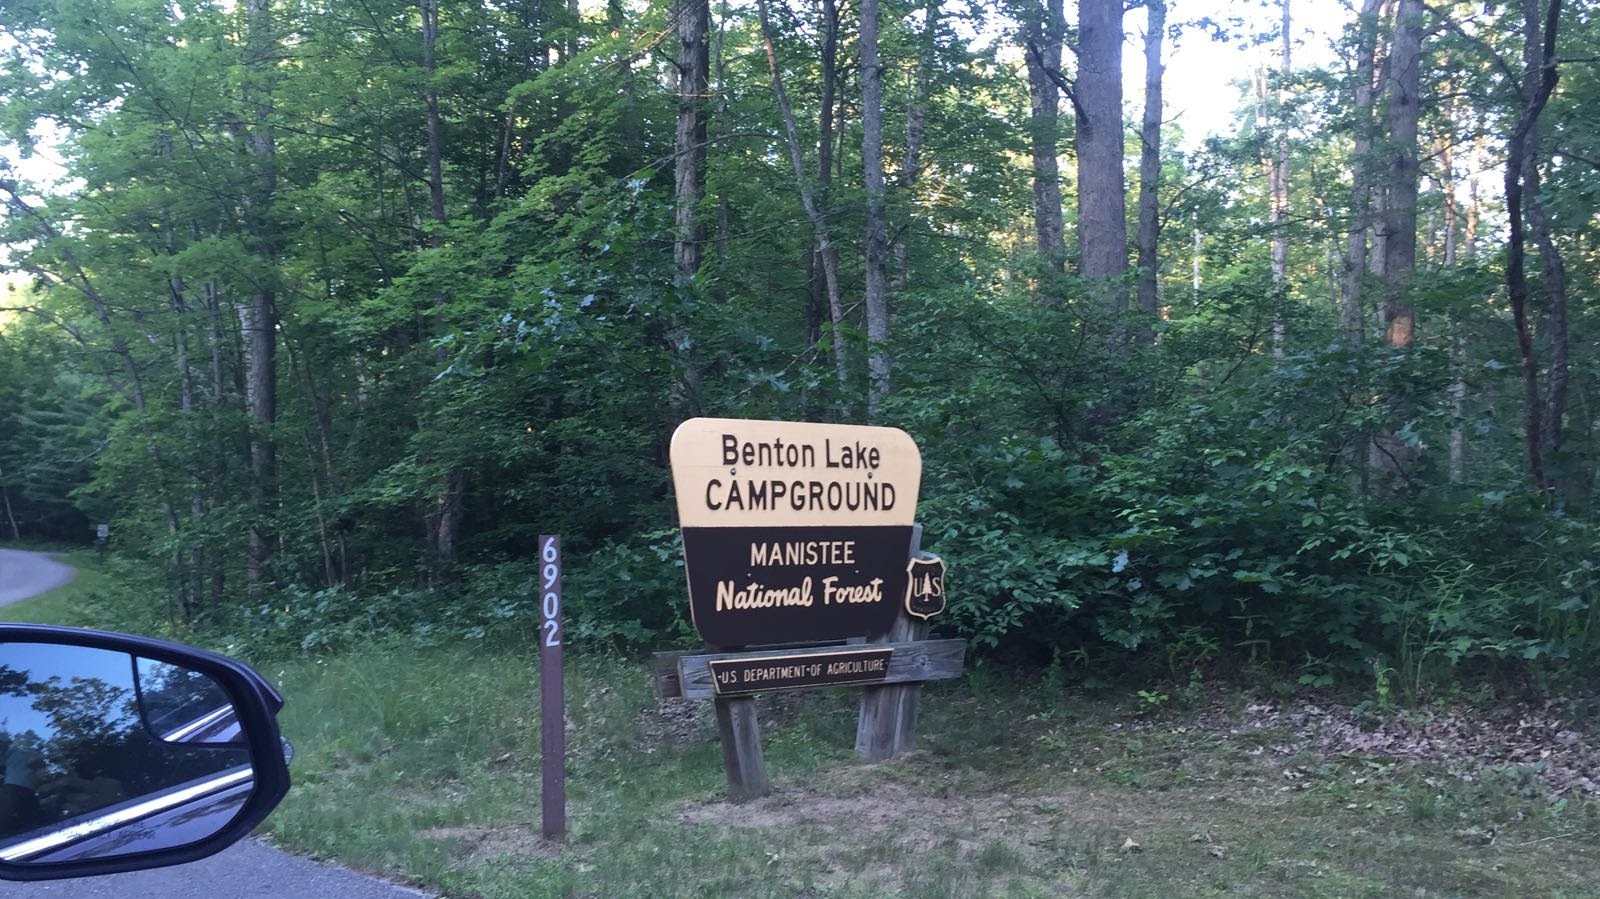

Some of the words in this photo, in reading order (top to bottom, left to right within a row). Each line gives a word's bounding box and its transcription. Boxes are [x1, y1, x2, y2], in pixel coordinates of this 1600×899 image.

[721, 434, 815, 467] Benton
[825, 438, 880, 469] Lake
[705, 478, 896, 511] CAMPGROUND
[750, 541, 855, 566] MANISTEE
[543, 537, 560, 647] 6902
[716, 576, 813, 612] National
[822, 576, 884, 605] Forest
[743, 666, 805, 682] DEPARTMENT
[810, 664, 822, 676] OF
[827, 658, 885, 675] AGRICULTURE
